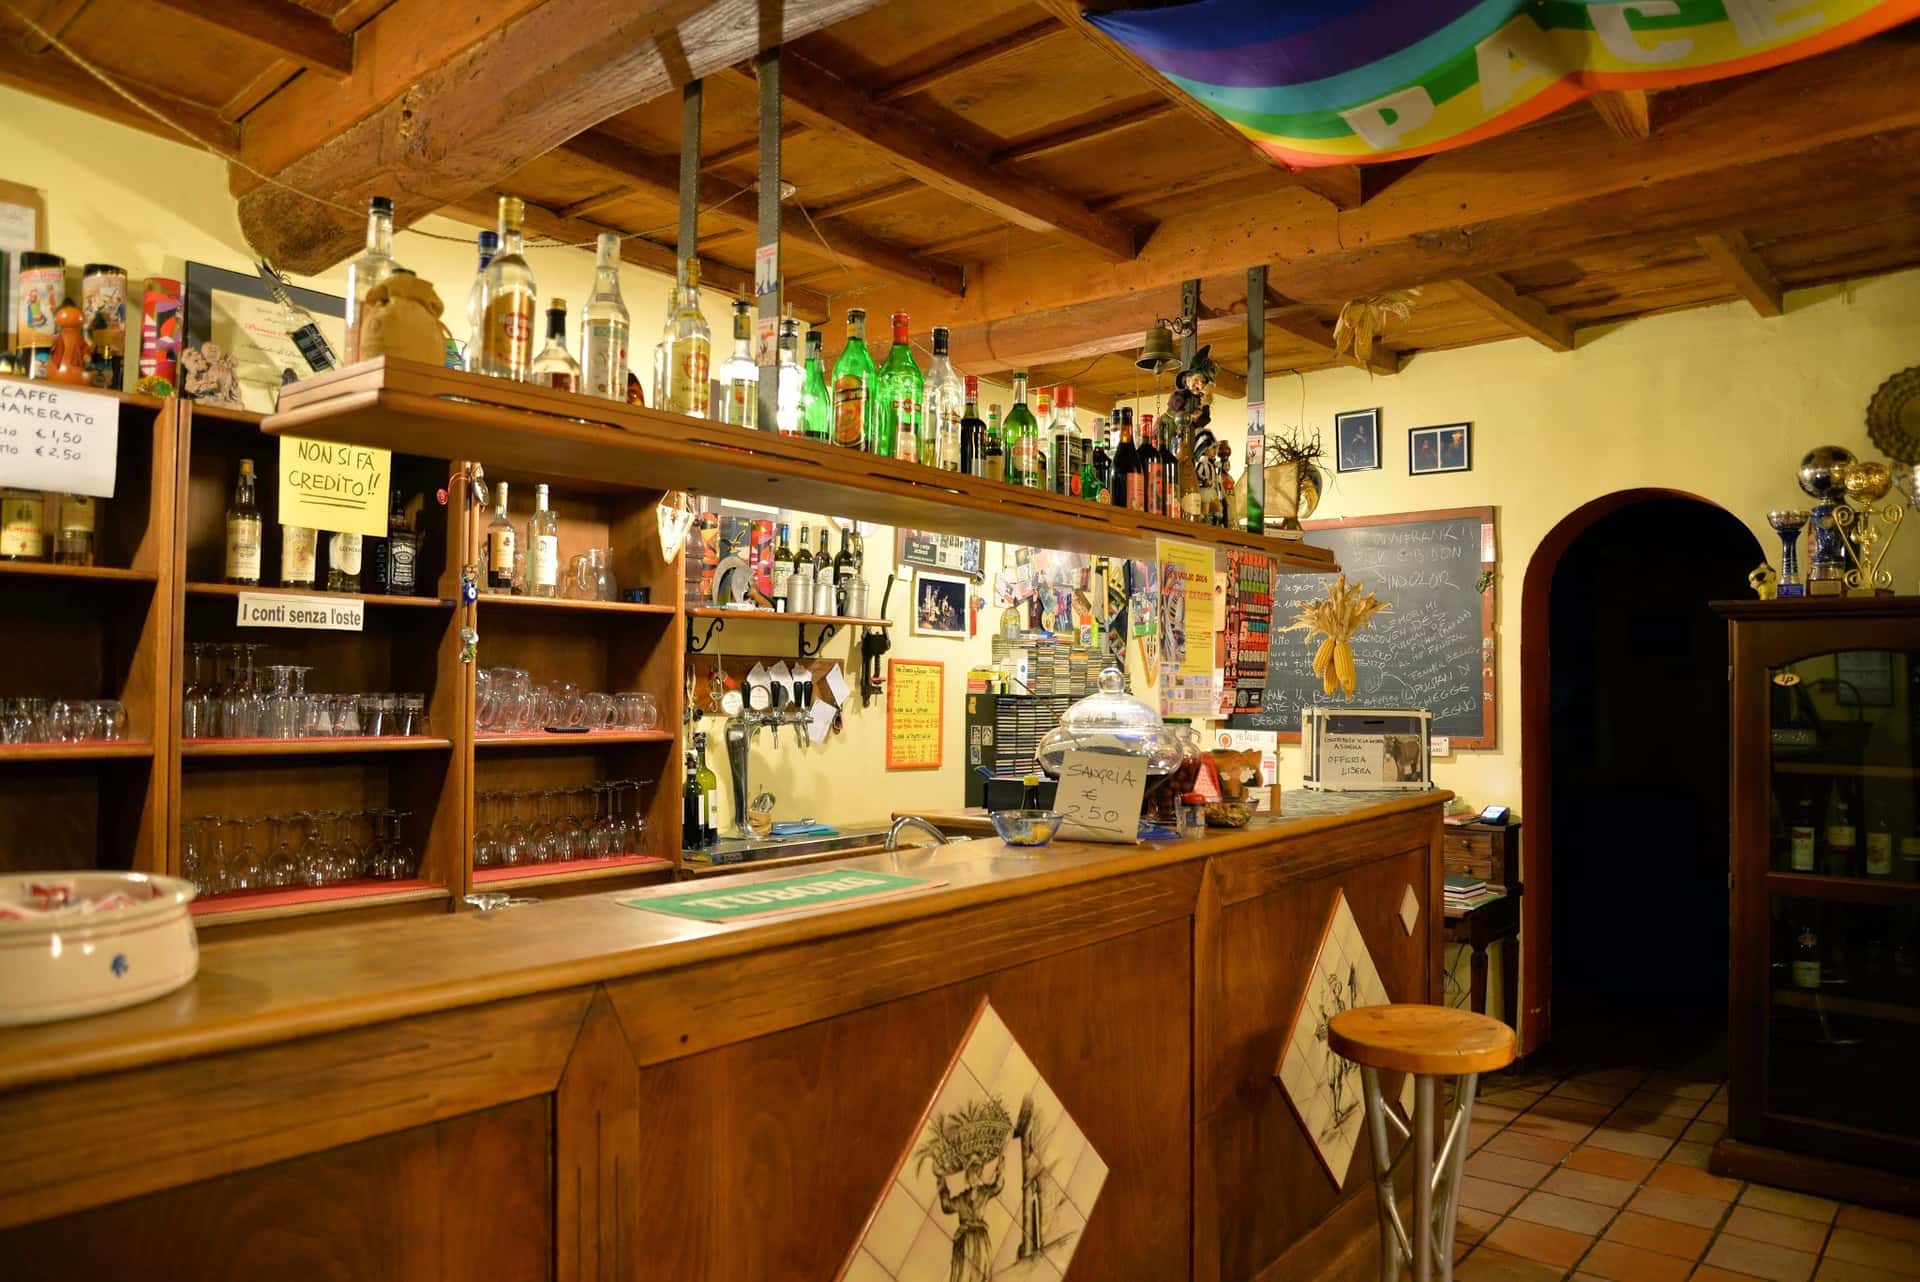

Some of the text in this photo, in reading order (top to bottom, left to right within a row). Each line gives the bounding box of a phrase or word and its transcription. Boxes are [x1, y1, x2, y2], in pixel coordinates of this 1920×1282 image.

[1338, 0, 1826, 149] PACE
[299, 441, 332, 464] NON
[243, 603, 361, 626] I conti senza l'oste
[1066, 763, 1137, 788] SANGRIA
[1063, 804, 1119, 823] 2.50
